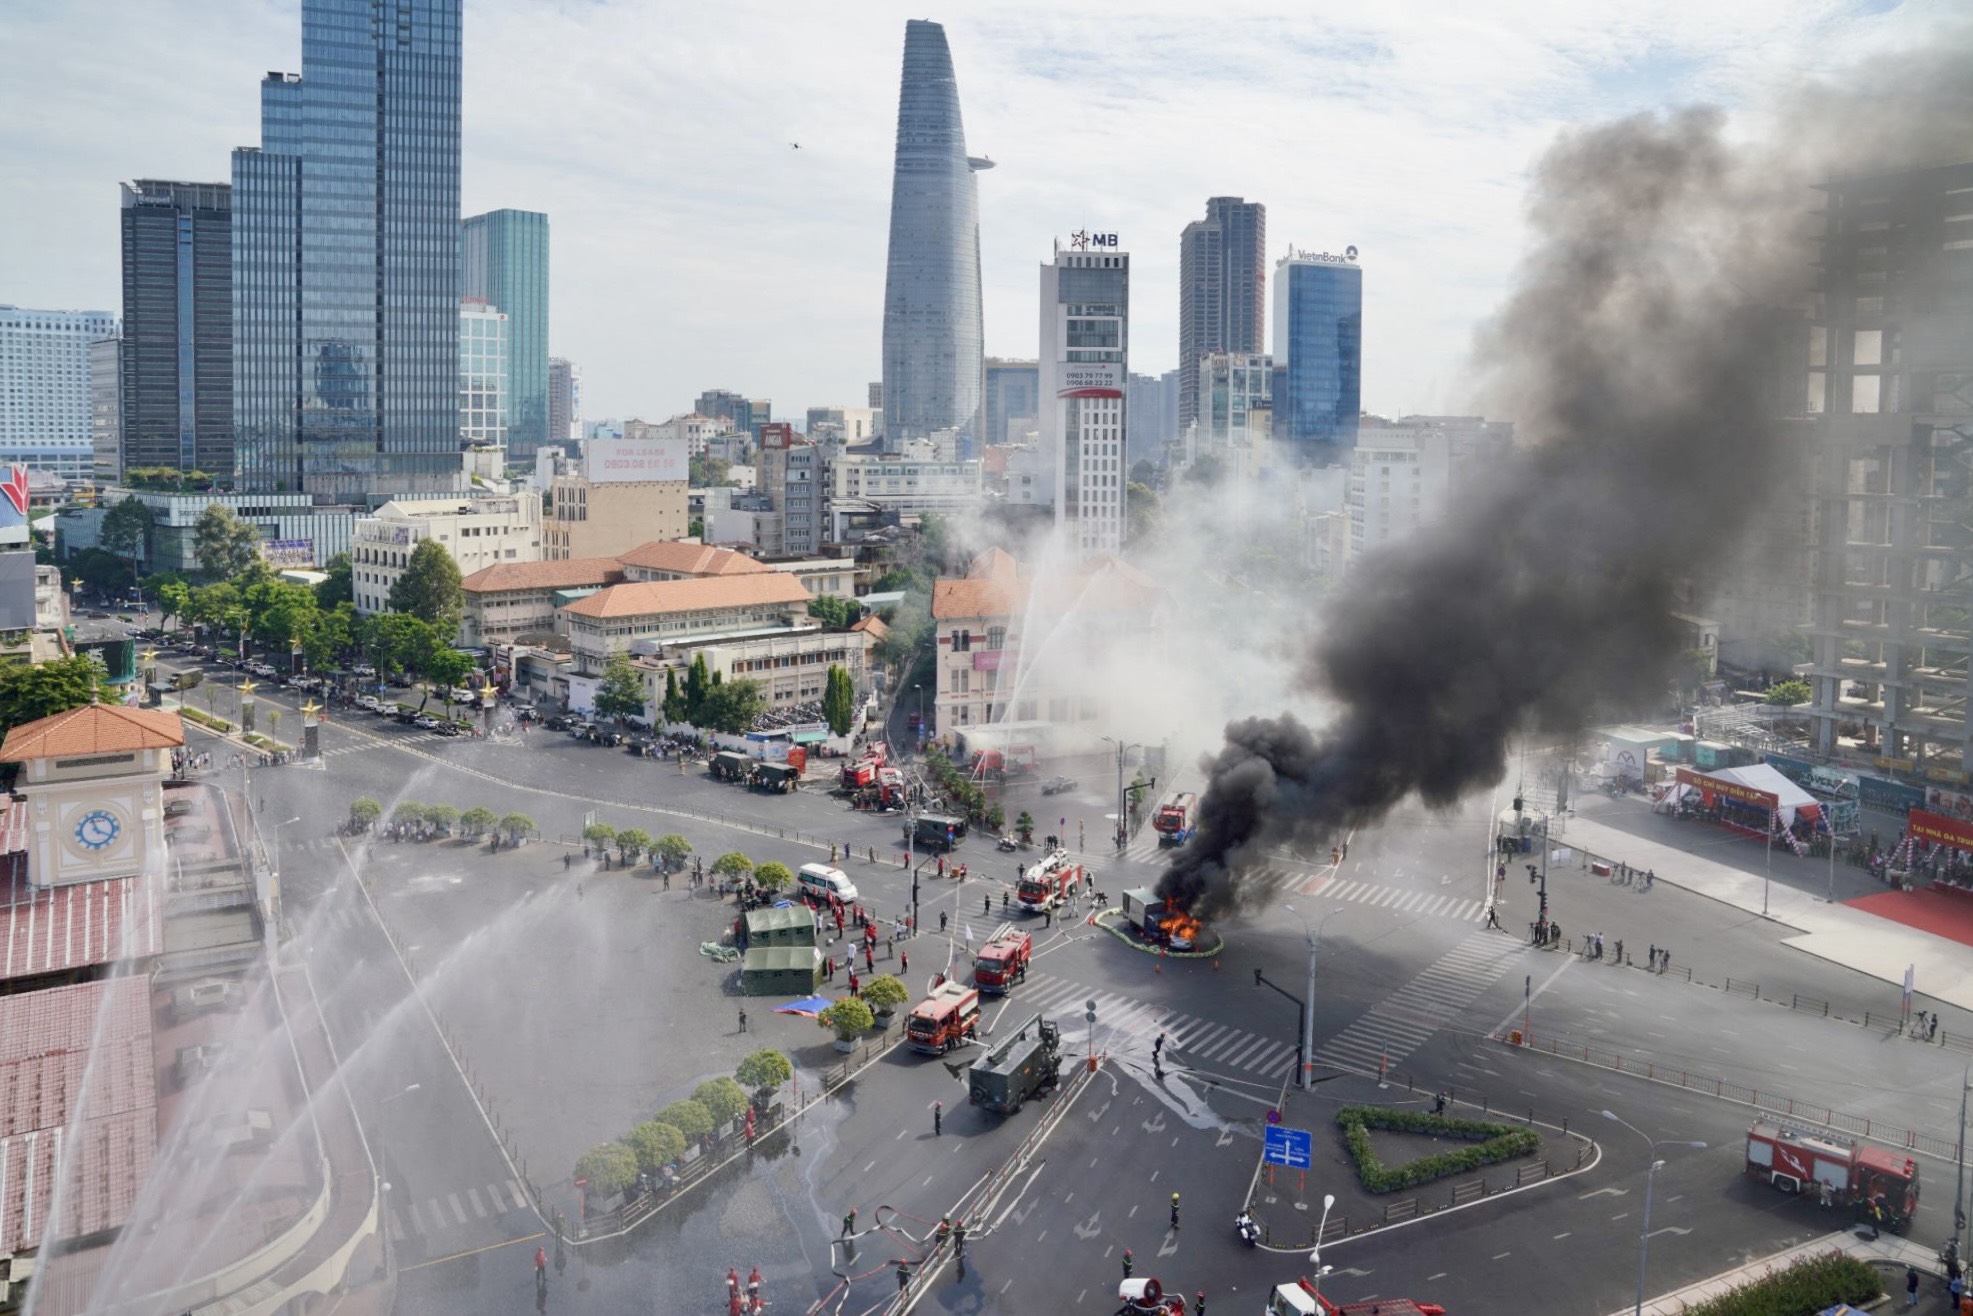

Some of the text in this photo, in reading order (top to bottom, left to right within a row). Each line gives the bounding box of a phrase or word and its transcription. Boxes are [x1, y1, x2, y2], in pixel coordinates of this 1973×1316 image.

[1092, 234, 1118, 246] MB
[1298, 249, 1346, 264] VietinBank
[616, 448, 634, 456] FOR
